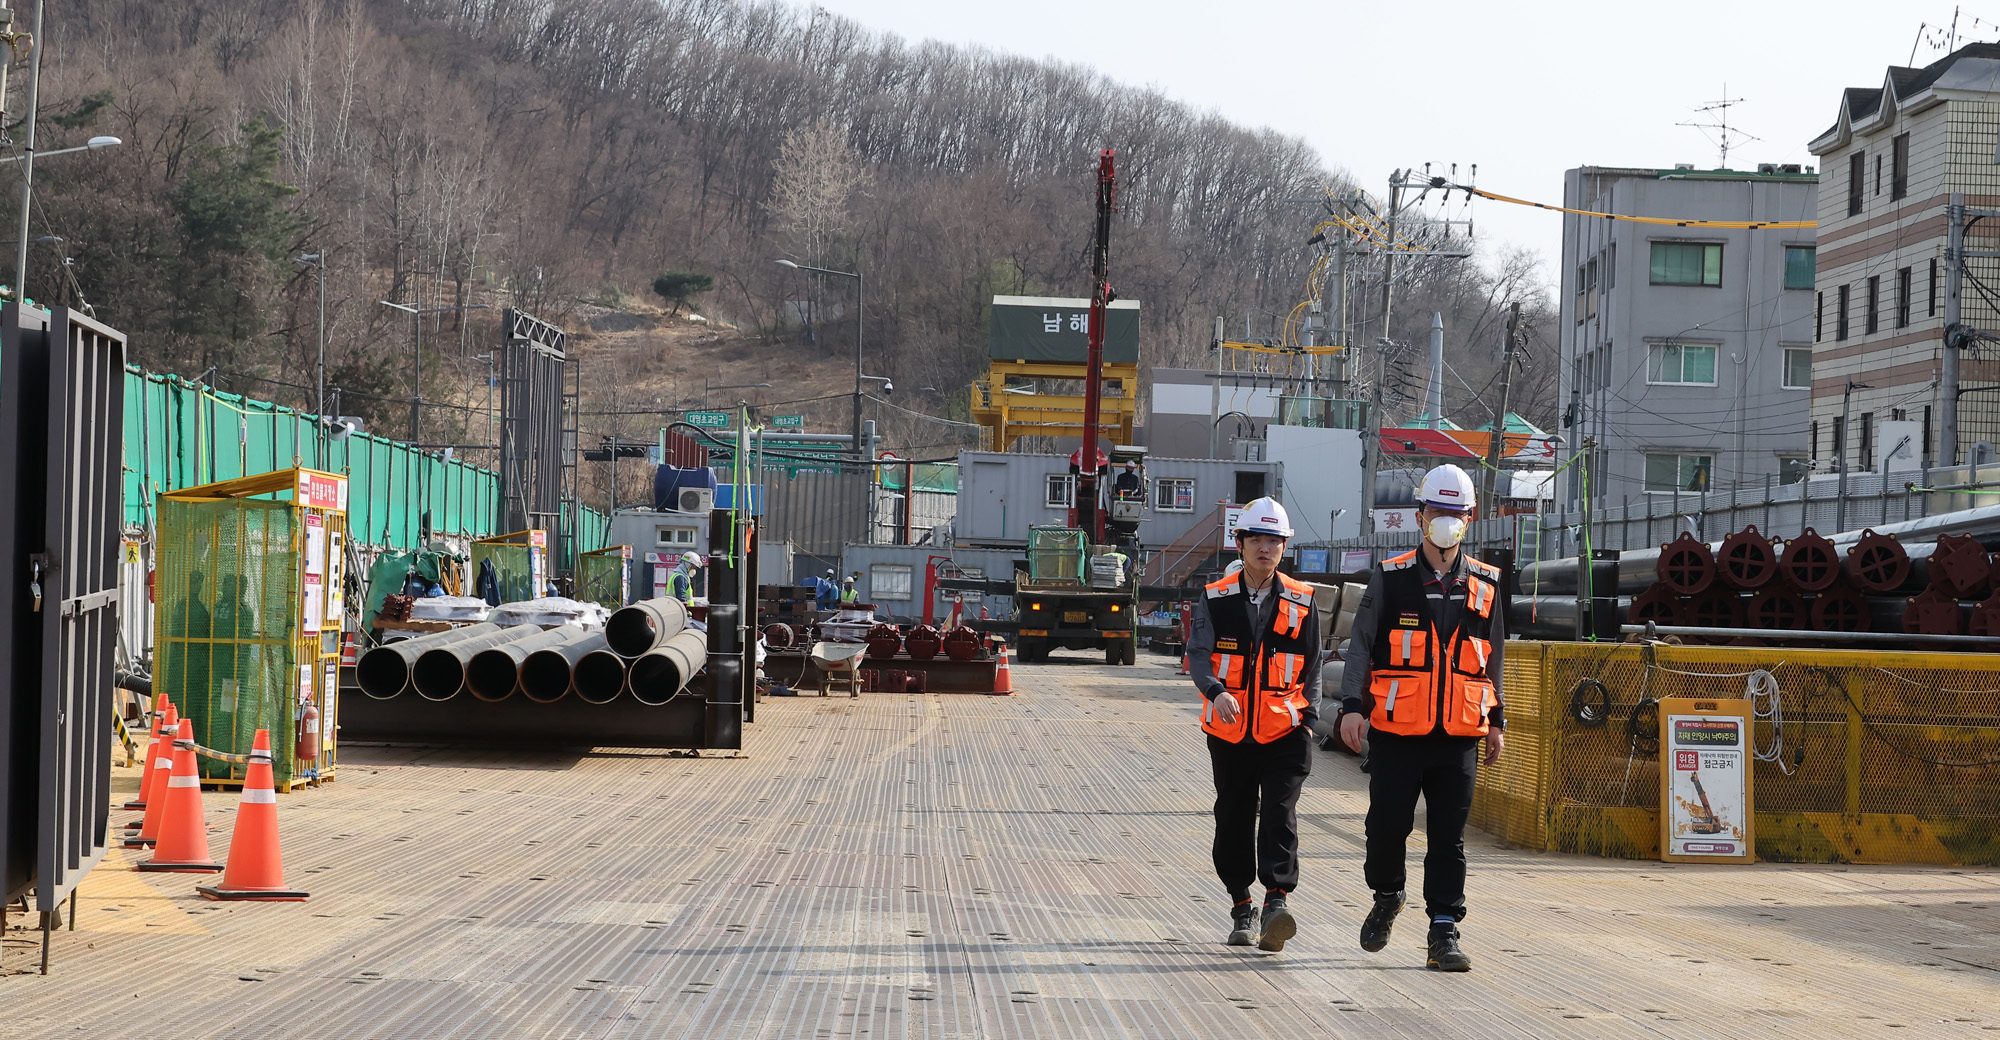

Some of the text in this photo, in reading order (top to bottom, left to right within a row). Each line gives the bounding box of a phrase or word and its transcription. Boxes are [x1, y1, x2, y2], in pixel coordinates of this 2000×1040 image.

[311, 481, 336, 502] 위험물저장소
[1384, 511, 1404, 529] 꽃
[1678, 731, 1737, 741] 자재 인양시 낙하주의
[1679, 753, 1696, 764] 위험
[1704, 759, 1734, 769] 접근금지
